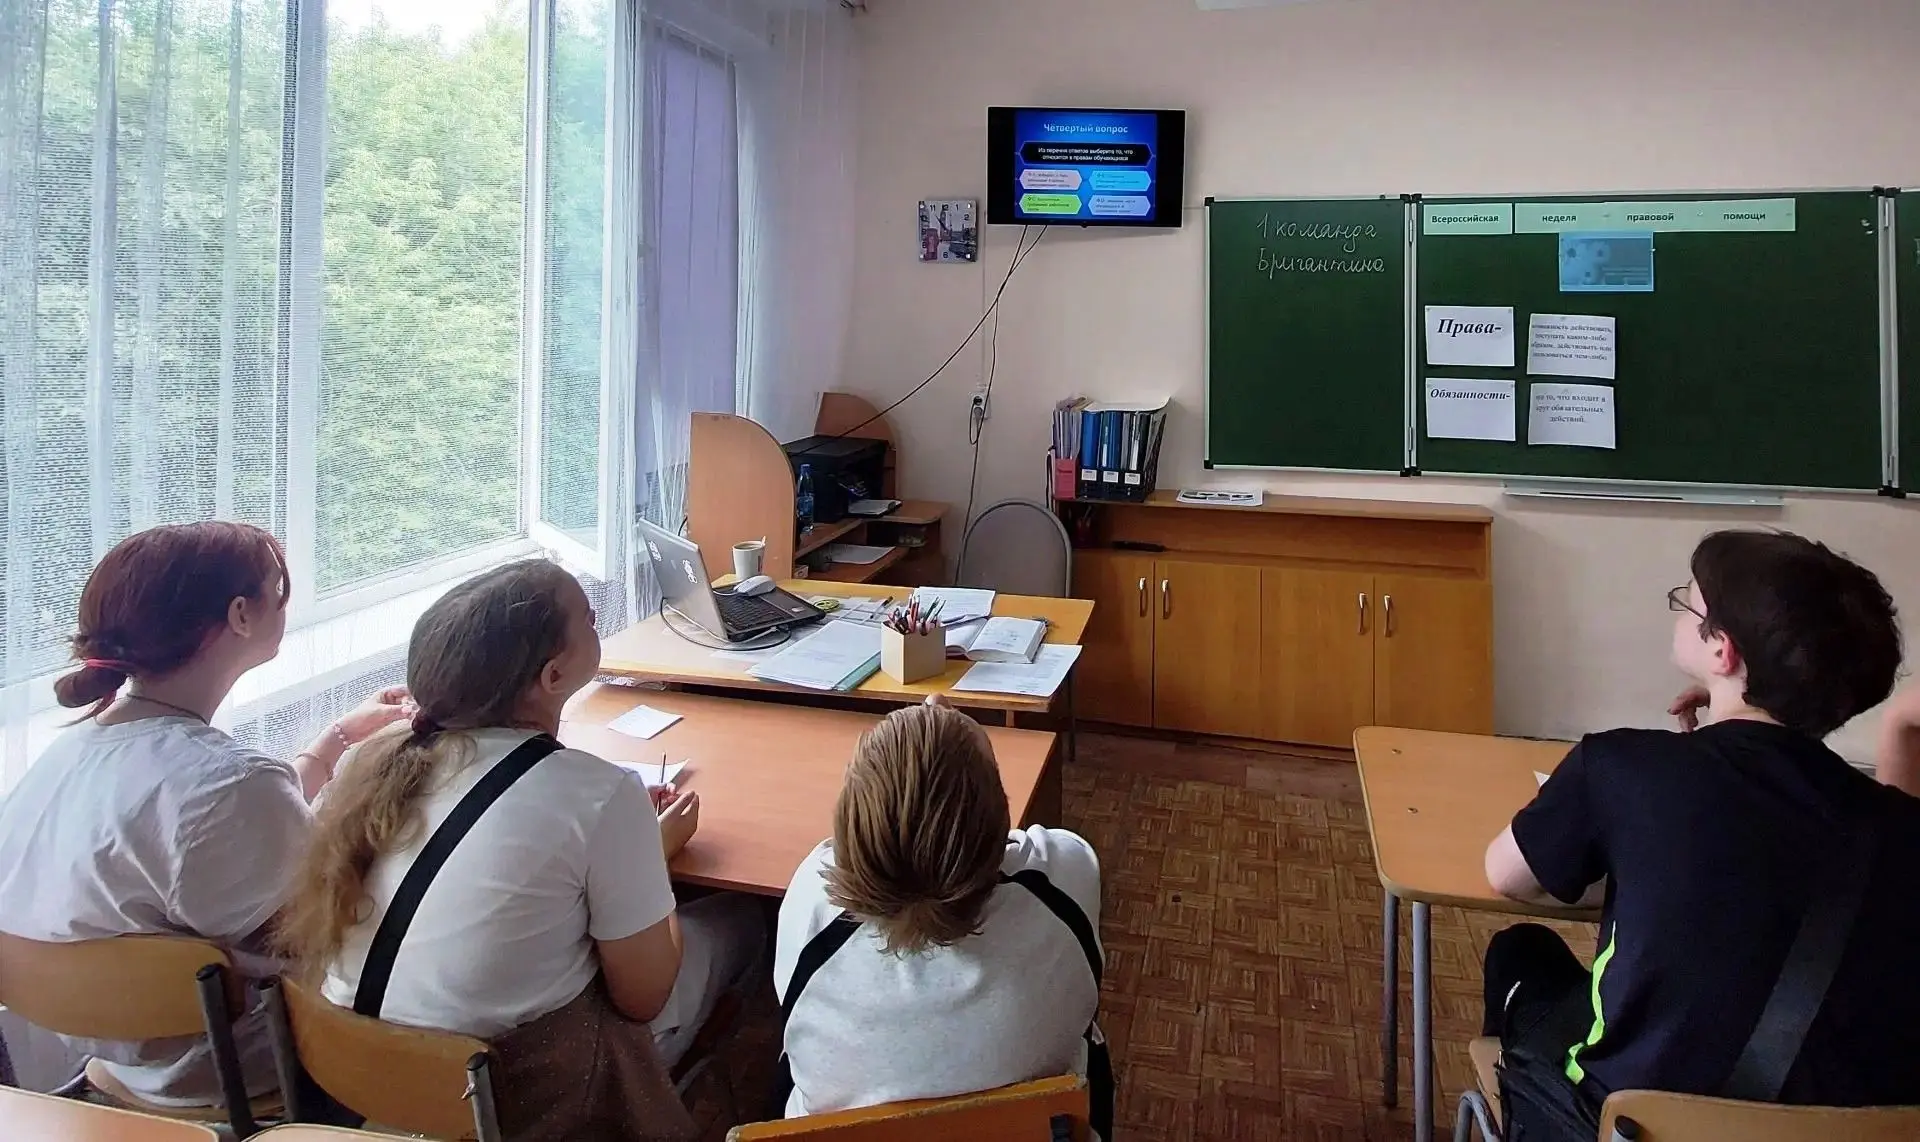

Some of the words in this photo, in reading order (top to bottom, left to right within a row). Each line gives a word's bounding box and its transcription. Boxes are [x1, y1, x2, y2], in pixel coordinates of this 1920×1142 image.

[1043, 123, 1094, 134] Четвертый
[1095, 125, 1129, 135] вопрос
[1431, 214, 1499, 224] Всероссийская
[1542, 214, 1577, 223] неделя
[1626, 212, 1674, 222] правовой
[1723, 212, 1766, 222] помощи
[1257, 213, 1269, 238] 1
[1276, 220, 1378, 253] команда
[1258, 247, 1385, 280] Бригантина
[1566, 333, 1607, 342] каким-либо
[1557, 343, 1598, 351] действовать
[1551, 404, 1605, 413] обязательных
